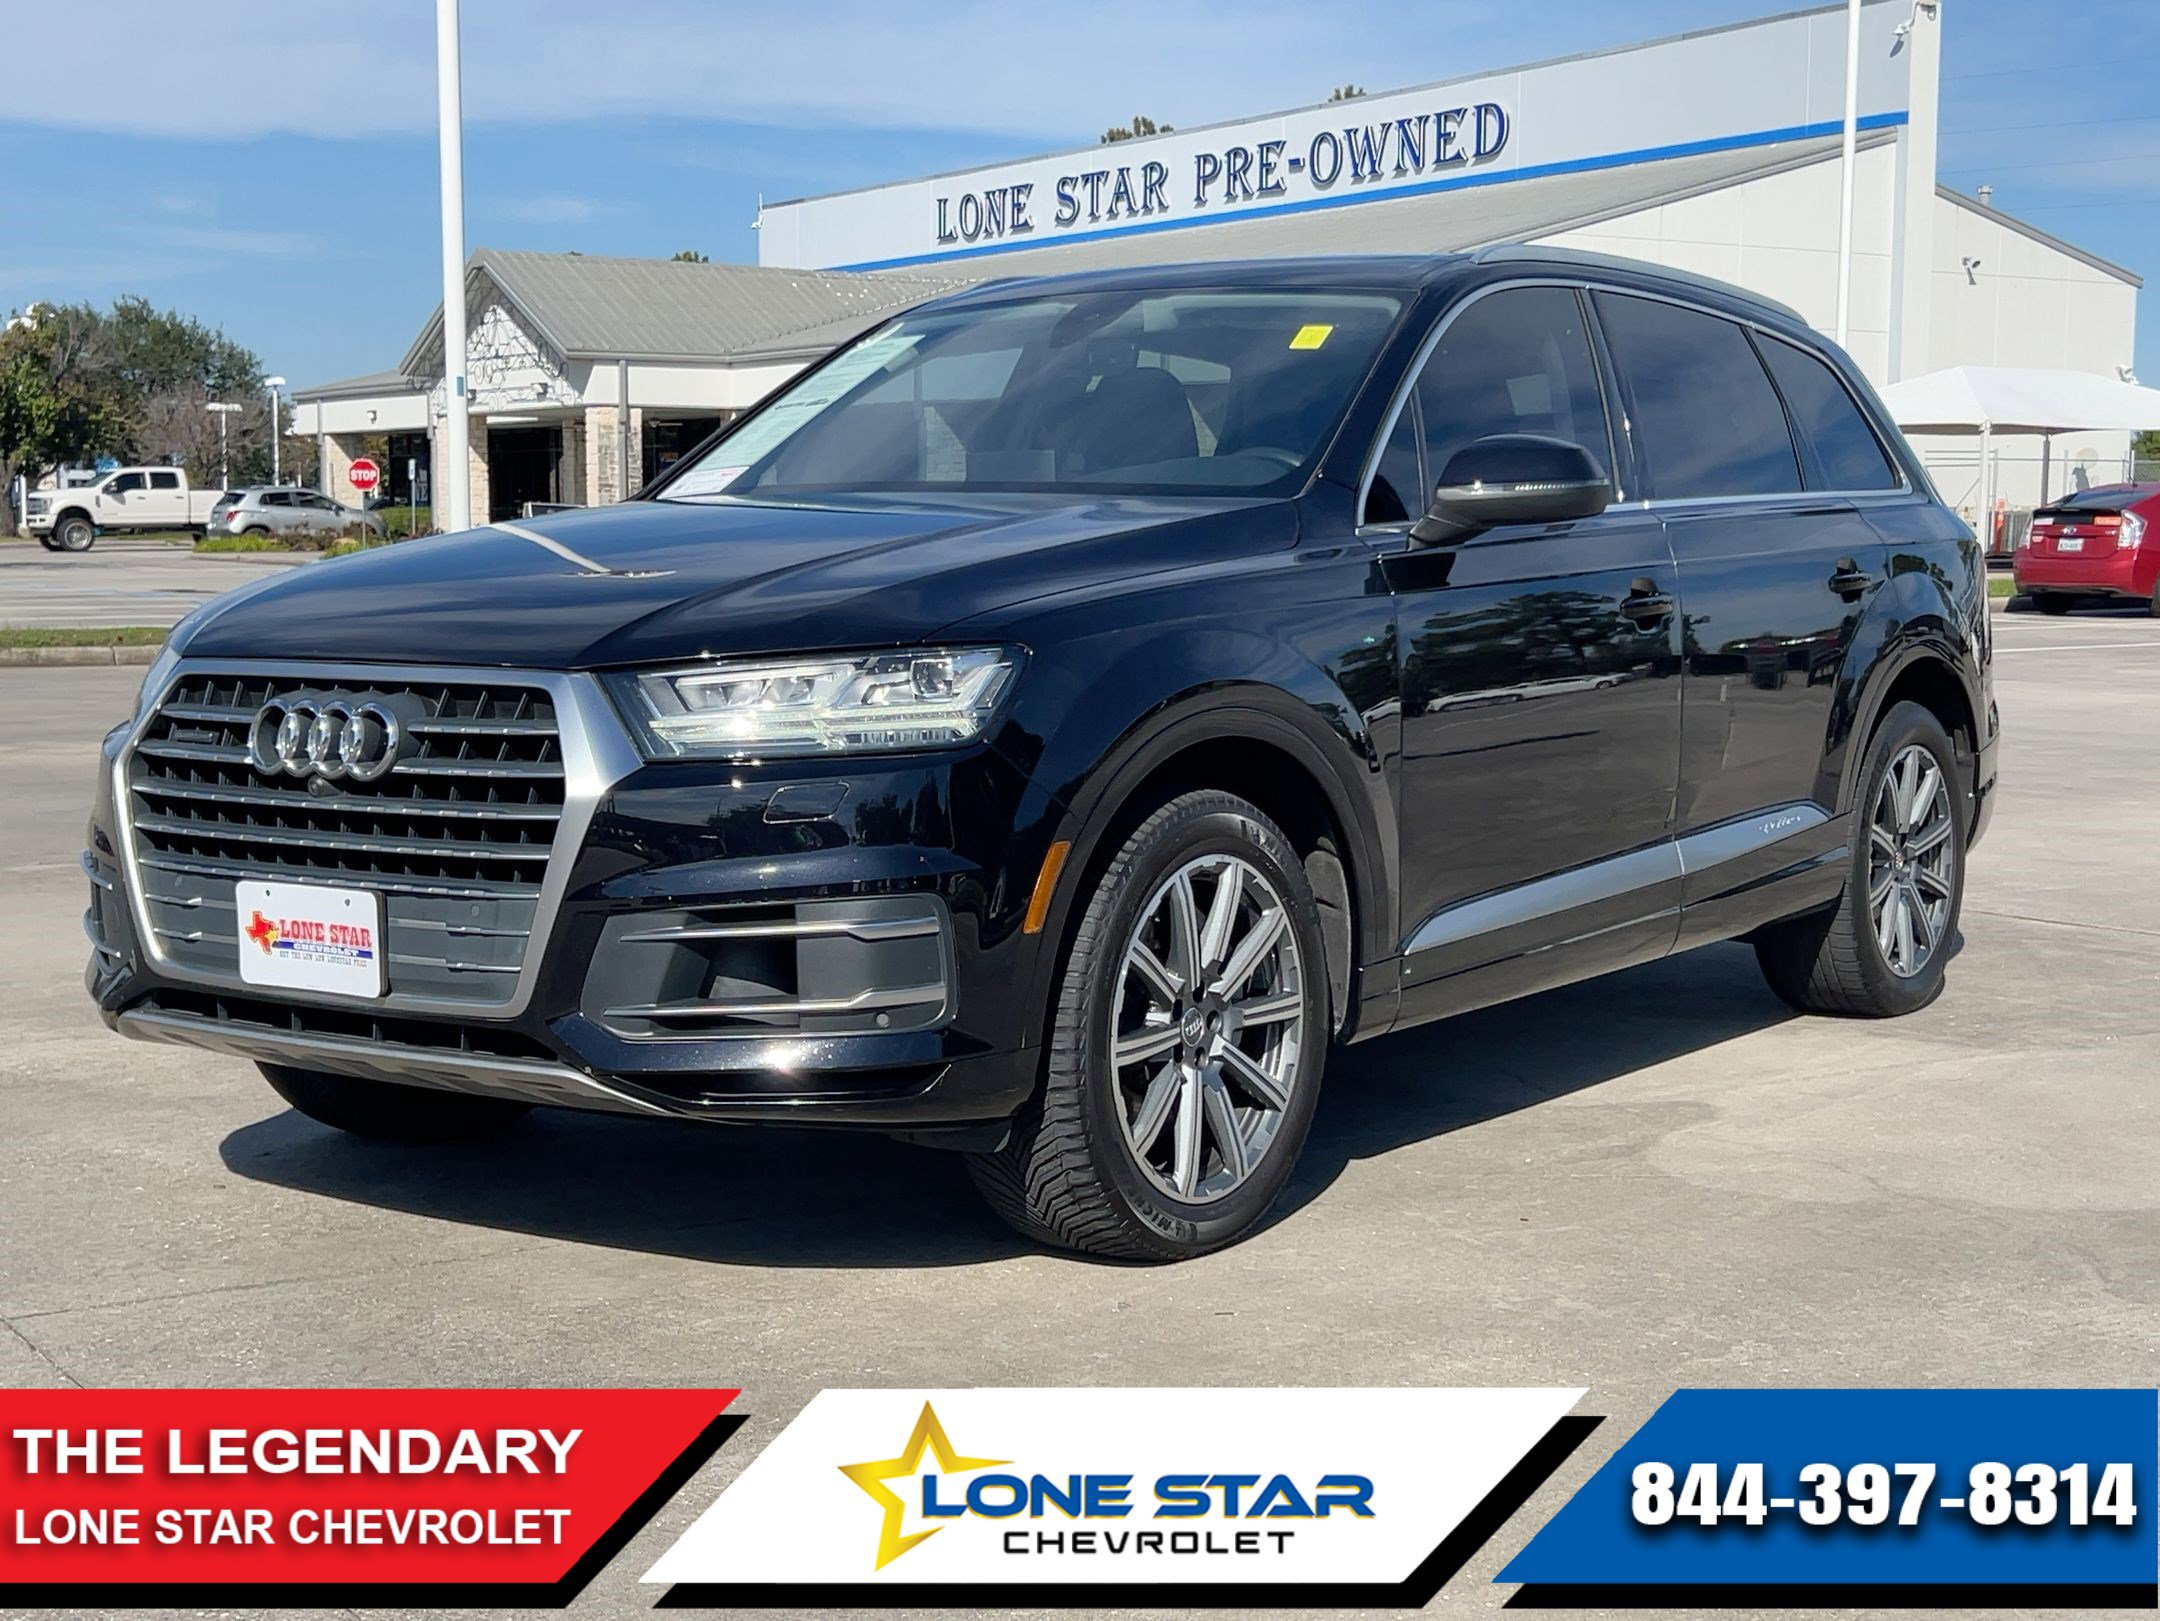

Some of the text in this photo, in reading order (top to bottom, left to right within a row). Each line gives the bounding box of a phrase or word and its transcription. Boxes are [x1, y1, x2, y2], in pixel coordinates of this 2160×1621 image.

[936, 102, 1510, 244] LONE STAR PRE-OWNED
[350, 469, 377, 481] STOP
[279, 918, 373, 948] LONE STAR
[293, 941, 359, 957] CHEVROLET
